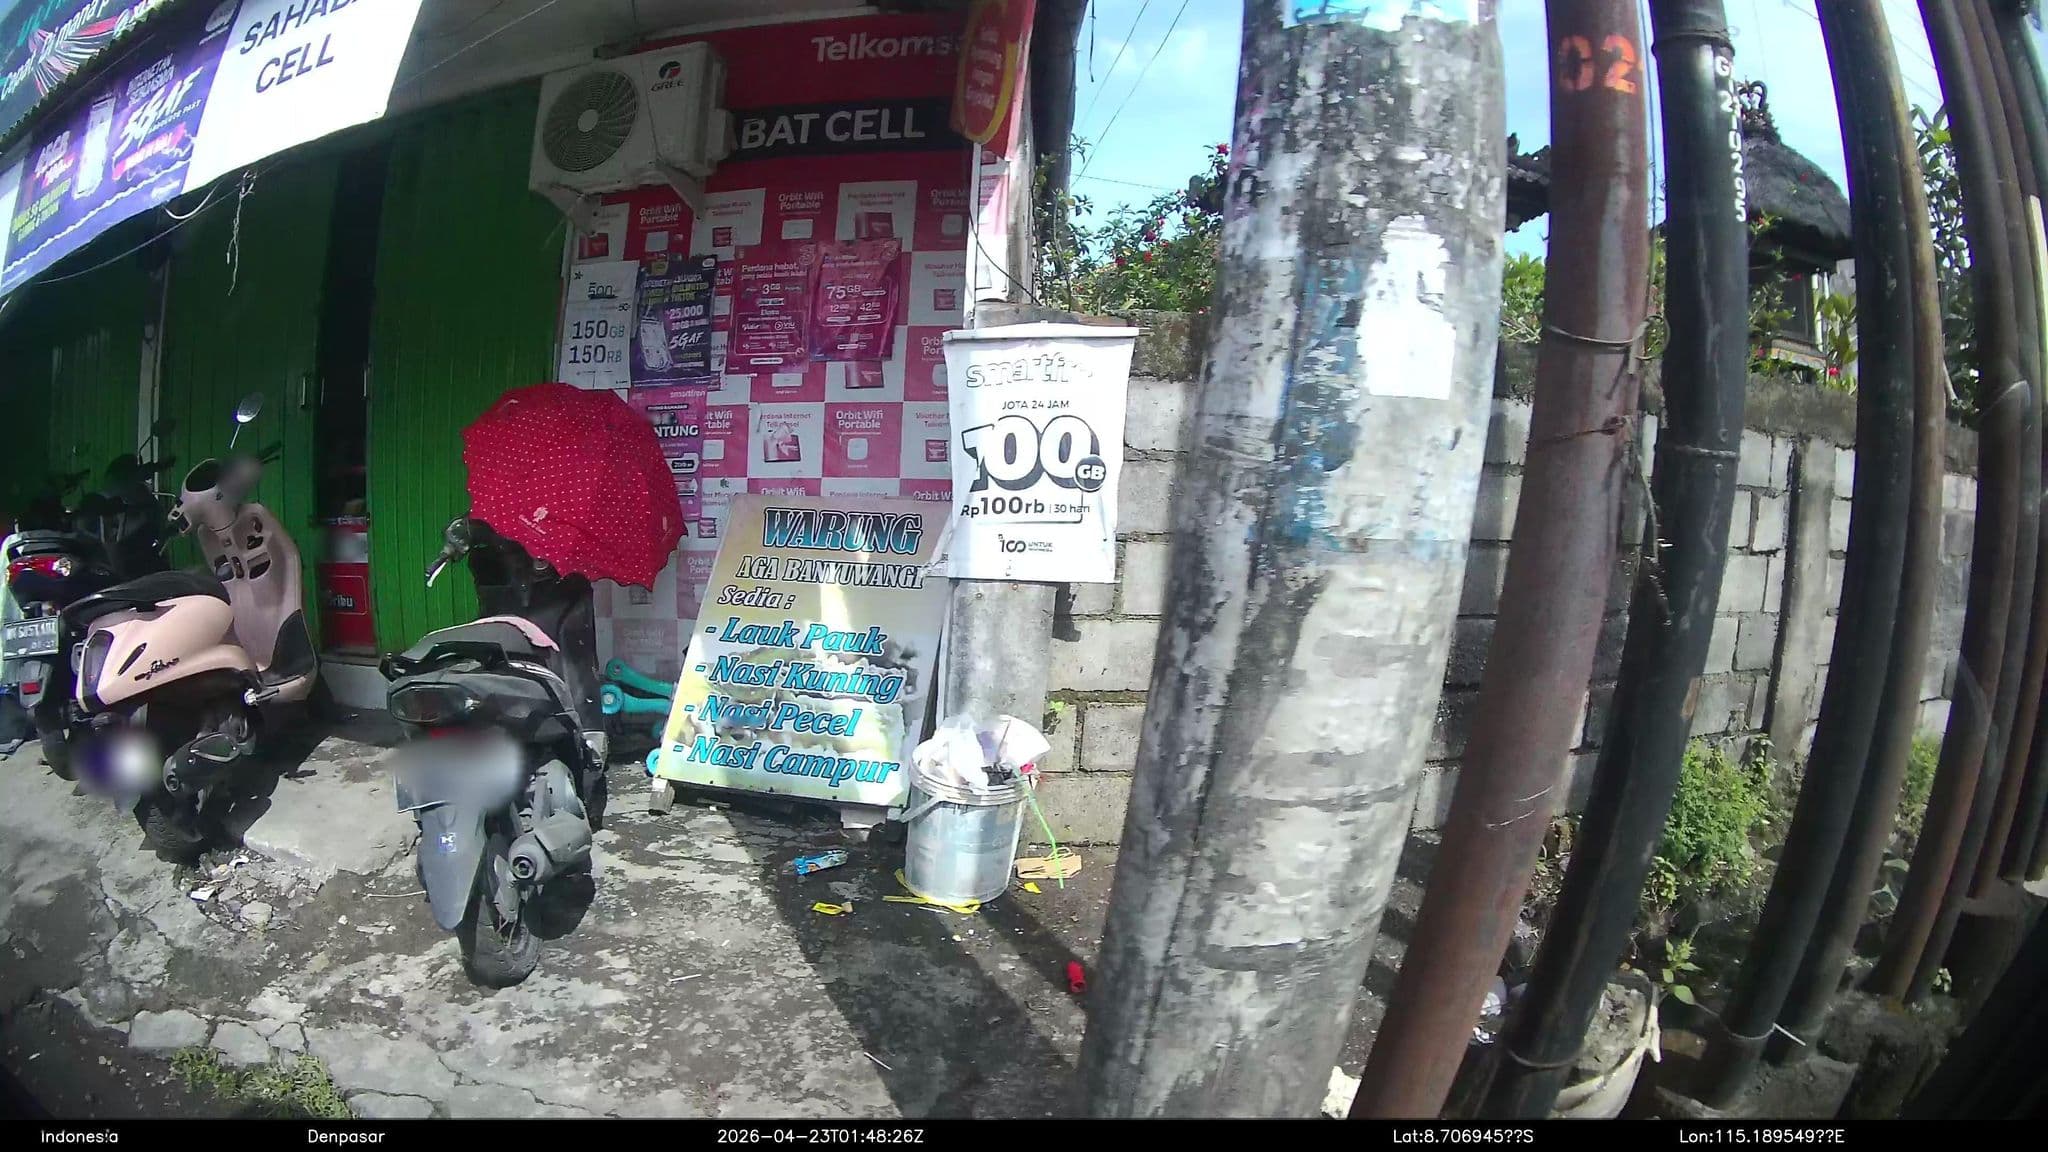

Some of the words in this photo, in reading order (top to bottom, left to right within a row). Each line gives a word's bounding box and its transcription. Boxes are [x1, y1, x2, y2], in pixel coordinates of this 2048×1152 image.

[256, 33, 334, 93] CELL
[651, 79, 684, 92] GREE
[738, 113, 820, 151] BAT
[825, 108, 925, 142] CELL
[778, 191, 802, 203] Orbit
[804, 190, 824, 201] Wifi
[780, 200, 820, 211] Portable
[572, 319, 625, 340] 150GB
[669, 331, 704, 350] 5GAF
[921, 336, 944, 346] Orbi
[568, 344, 622, 364] 150RB
[1032, 400, 1044, 410] 24
[1047, 399, 1070, 410] JAM
[760, 412, 783, 421] erdana
[836, 410, 861, 420] Orbit
[863, 409, 884, 419] Wifi
[838, 419, 881, 429] Portable
[654, 425, 699, 438] NTUNG
[705, 419, 731, 430] table
[962, 415, 1100, 492] 100
[1077, 464, 1106, 481] GB
[1054, 503, 1067, 513] 30
[763, 507, 923, 556] WARUNG
[735, 556, 779, 581] AGA
[782, 558, 924, 589] BANYUWANGI
[717, 585, 783, 608] Sedia
[719, 617, 800, 648] Lauk
[801, 624, 888, 656] Pauk
[709, 656, 783, 687] Nasi
[782, 662, 904, 703] Kuning
[699, 695, 770, 729] Nasi
[771, 703, 863, 736] Pecel
[687, 736, 762, 769] Nasi
[763, 745, 899, 787] Campur
